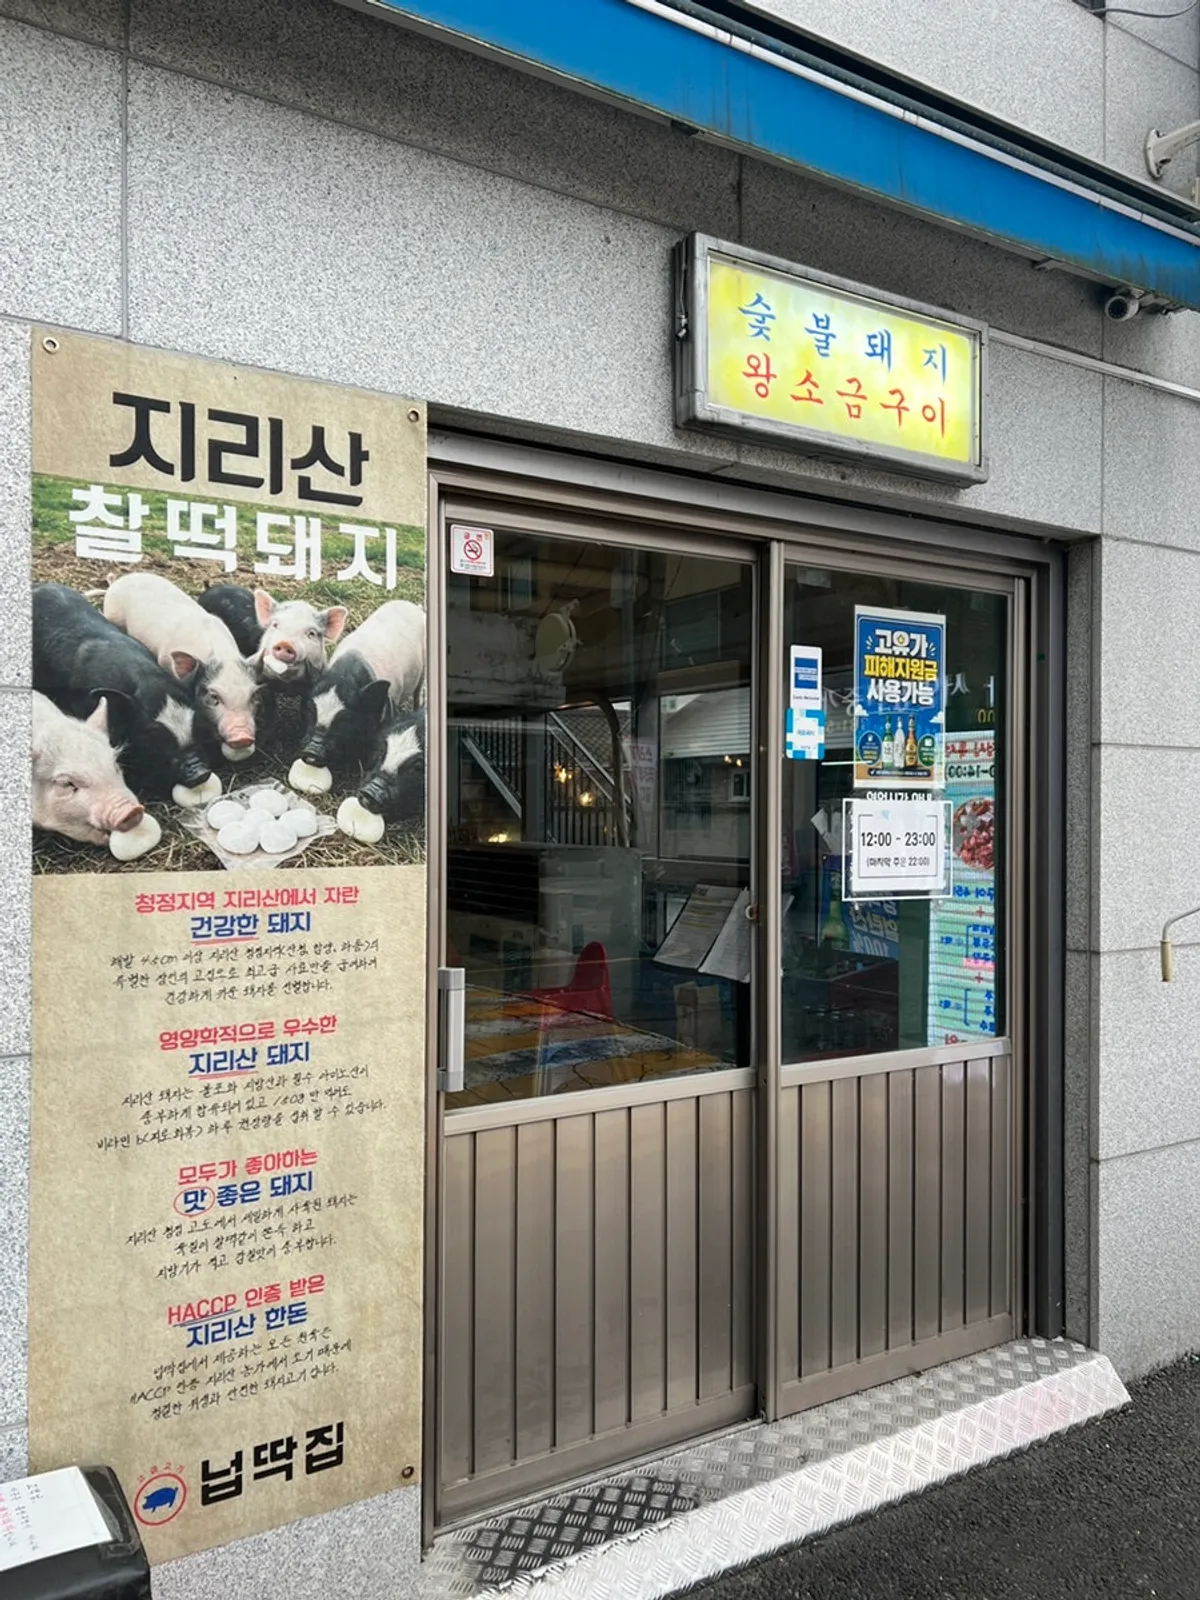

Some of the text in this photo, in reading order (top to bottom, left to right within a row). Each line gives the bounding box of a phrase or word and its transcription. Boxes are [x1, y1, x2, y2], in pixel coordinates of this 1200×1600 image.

[110, 391, 370, 507] 지리산
[69, 484, 398, 591] 찰떡돼지
[874, 629, 928, 657] 고유가
[864, 655, 938, 682] 피해지원금
[866, 677, 934, 705] 사용가능
[861, 832, 892, 847] 12:00
[904, 832, 936, 847] 23:00
[135, 885, 360, 914] 청정지역 지리산에서 자란
[191, 911, 311, 939] 건강한 돼지
[209, 947, 239, 962] 지리산
[245, 964, 280, 979] 최고급
[159, 1015, 338, 1051] 영양학적으로 우수한
[188, 1041, 310, 1075] 지리산 돼지
[122, 1091, 152, 1107] 지리산
[159, 1088, 194, 1102] 돼지는
[96, 1133, 130, 1151] 비타민
[178, 1149, 318, 1185] 모두가 좋아하는
[183, 1171, 313, 1213] 맛 좋은 돼지
[125, 1228, 156, 1246] 지리산
[327, 1193, 358, 1209] 돼지는
[168, 1275, 325, 1325] HACCP 인증 받은
[186, 1301, 308, 1348] 지리산 한돈
[206, 1367, 235, 1386] 지리산
[201, 1421, 344, 1507] 넙딱집
